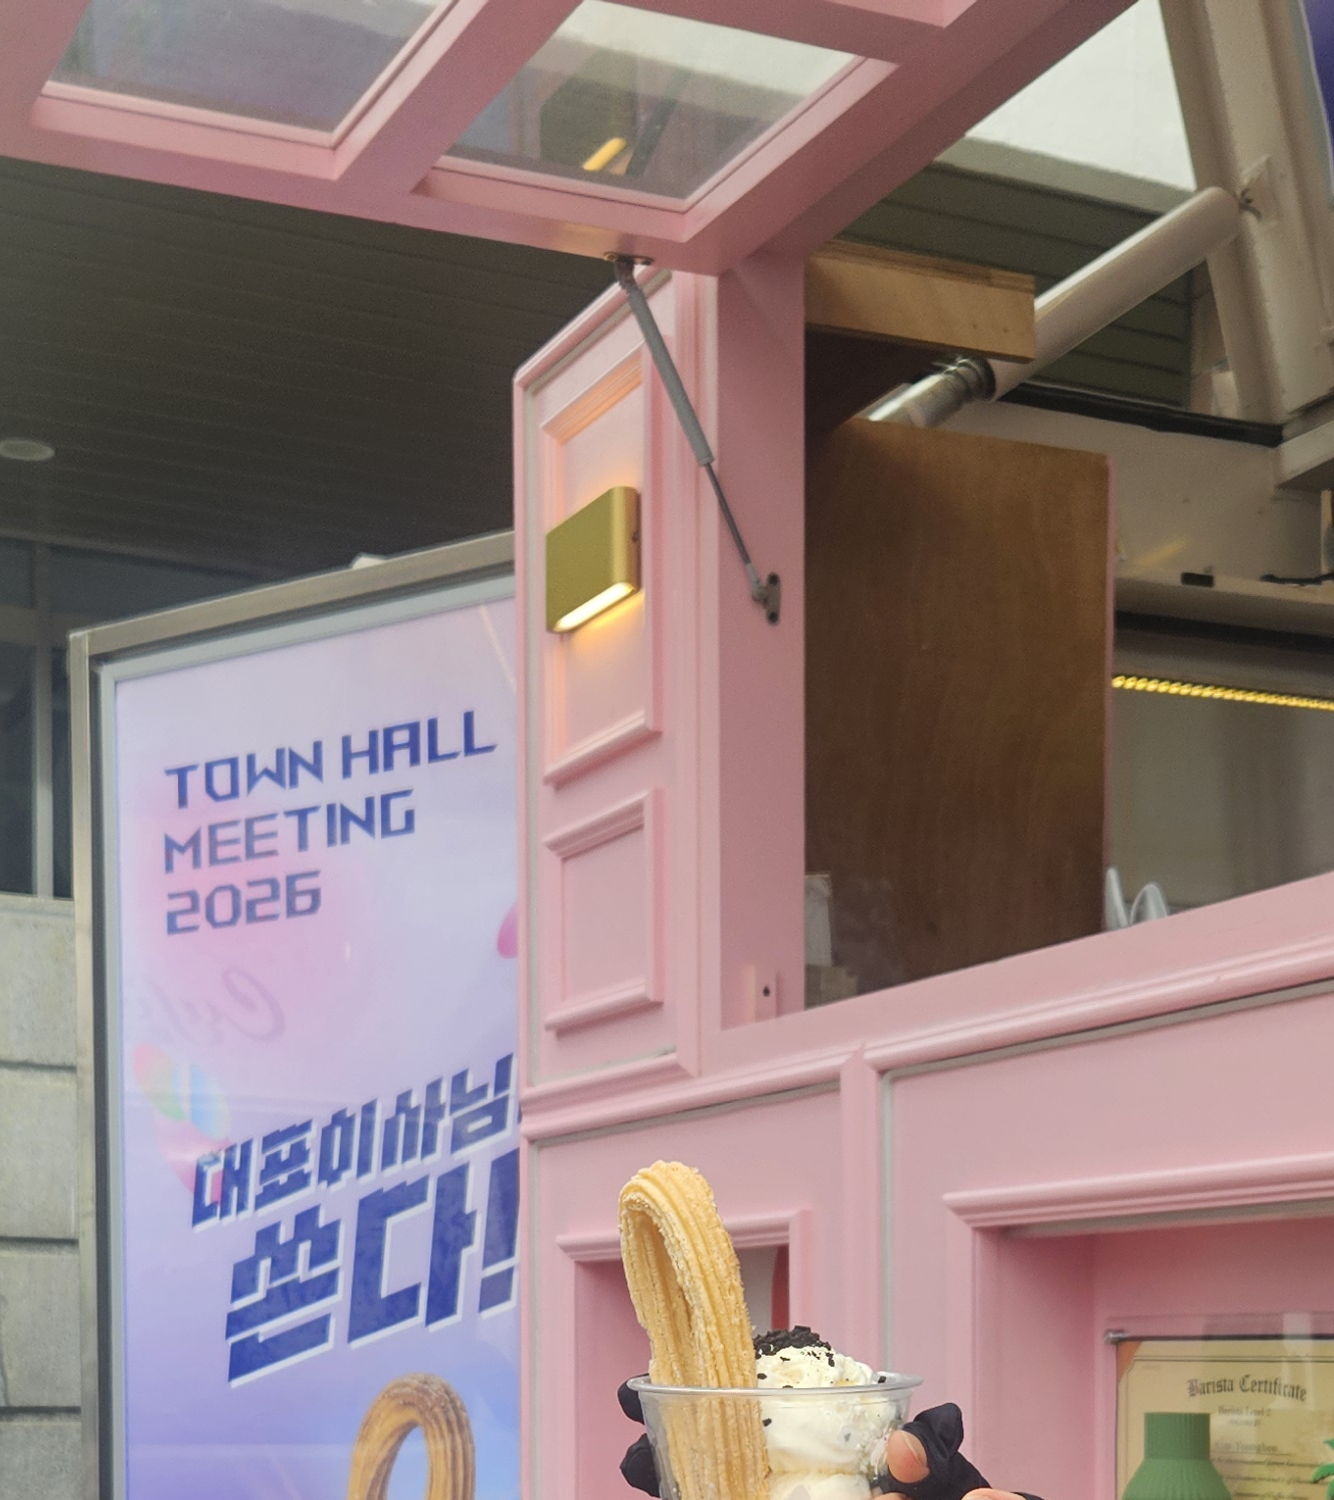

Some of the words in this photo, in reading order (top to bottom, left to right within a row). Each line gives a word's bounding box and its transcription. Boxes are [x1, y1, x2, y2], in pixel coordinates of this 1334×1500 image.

[165, 740, 323, 809] TOWN
[342, 711, 498, 779] HALL
[164, 788, 415, 874] MEETING
[167, 870, 322, 935] 2026
[192, 1053, 520, 1229] 대표이사님
[226, 1147, 520, 1385] 쓴다!
[1187, 1378, 1234, 1397] Barista
[1239, 1375, 1307, 1402] Certificate
